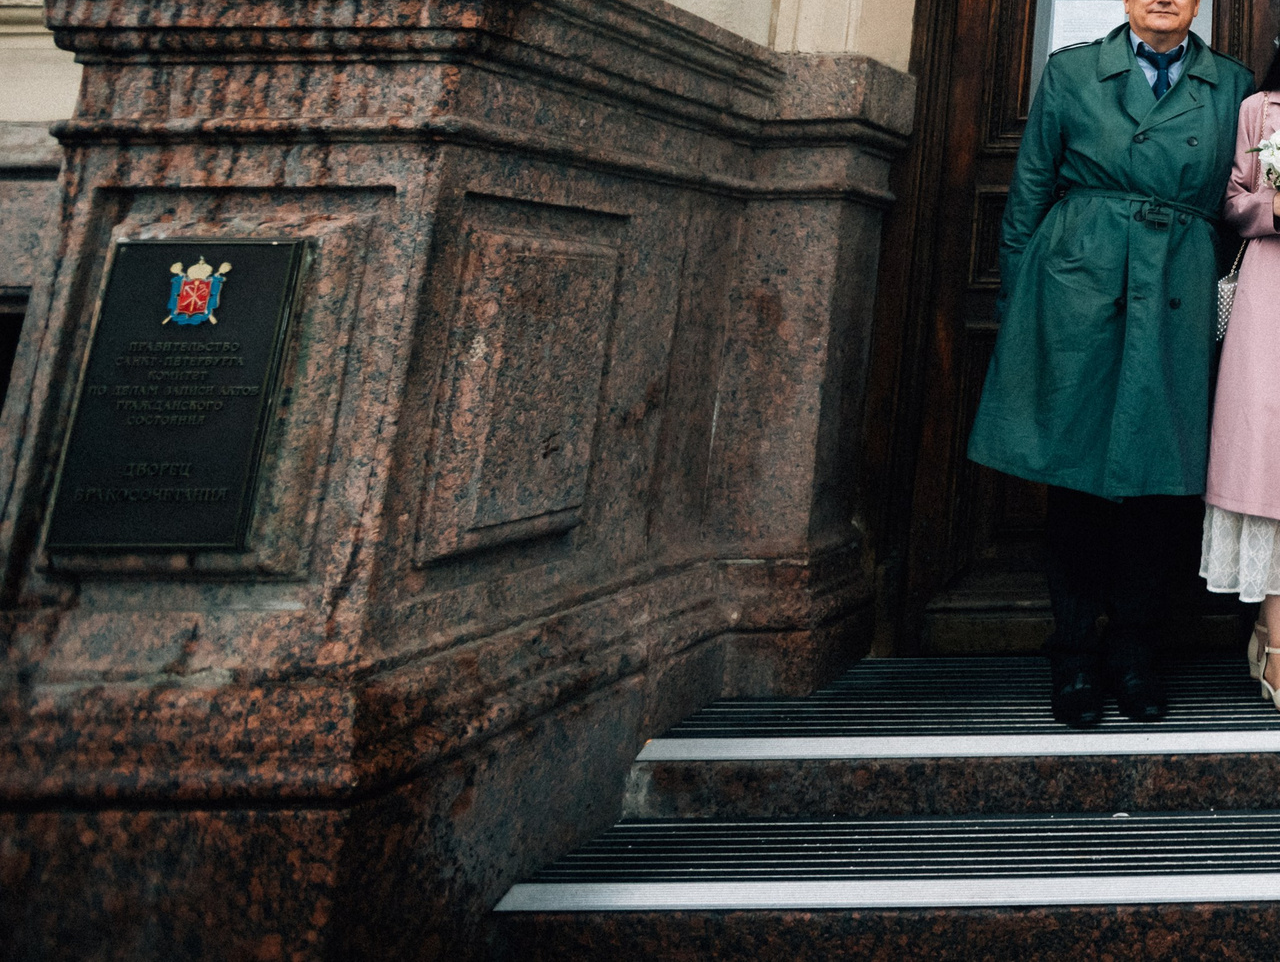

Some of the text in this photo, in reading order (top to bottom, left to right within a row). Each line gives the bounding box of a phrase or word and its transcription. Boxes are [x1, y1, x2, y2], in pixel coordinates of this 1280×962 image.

[129, 341, 240, 352] ПРАВИТЕЛЬСТВО
[149, 370, 209, 381] КОМИТЕТ
[115, 400, 224, 411] ГРАЖДАНСКОГО
[122, 462, 193, 477] ДВОРЕЦ
